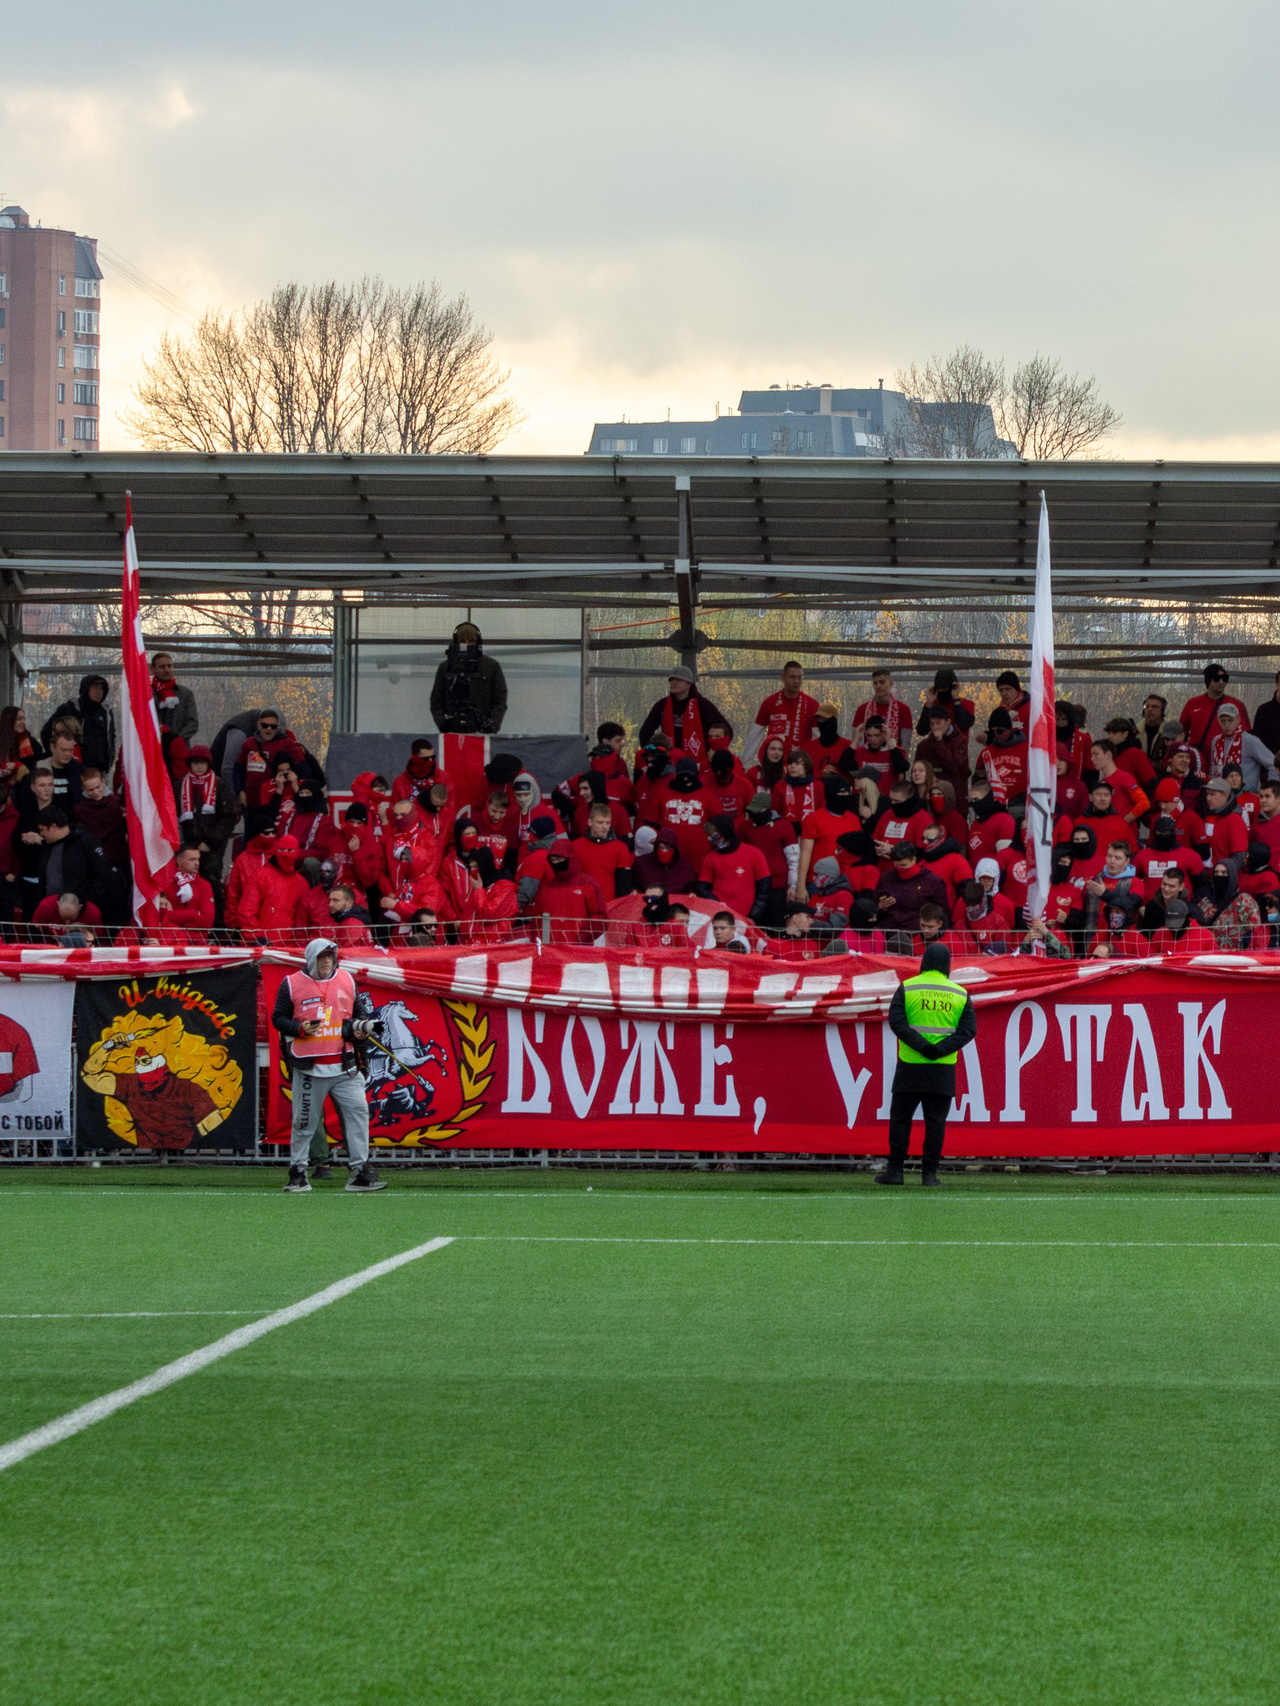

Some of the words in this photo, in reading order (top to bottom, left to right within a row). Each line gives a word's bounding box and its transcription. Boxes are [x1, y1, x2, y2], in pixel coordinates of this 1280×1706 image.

[920, 991, 953, 999] STEWARD
[119, 976, 237, 1040] U-brigade
[921, 999, 952, 1012] R130
[500, 1008, 767, 1135] БОЖЕ,
[15, 1111, 64, 1130] ТОБОЙ
